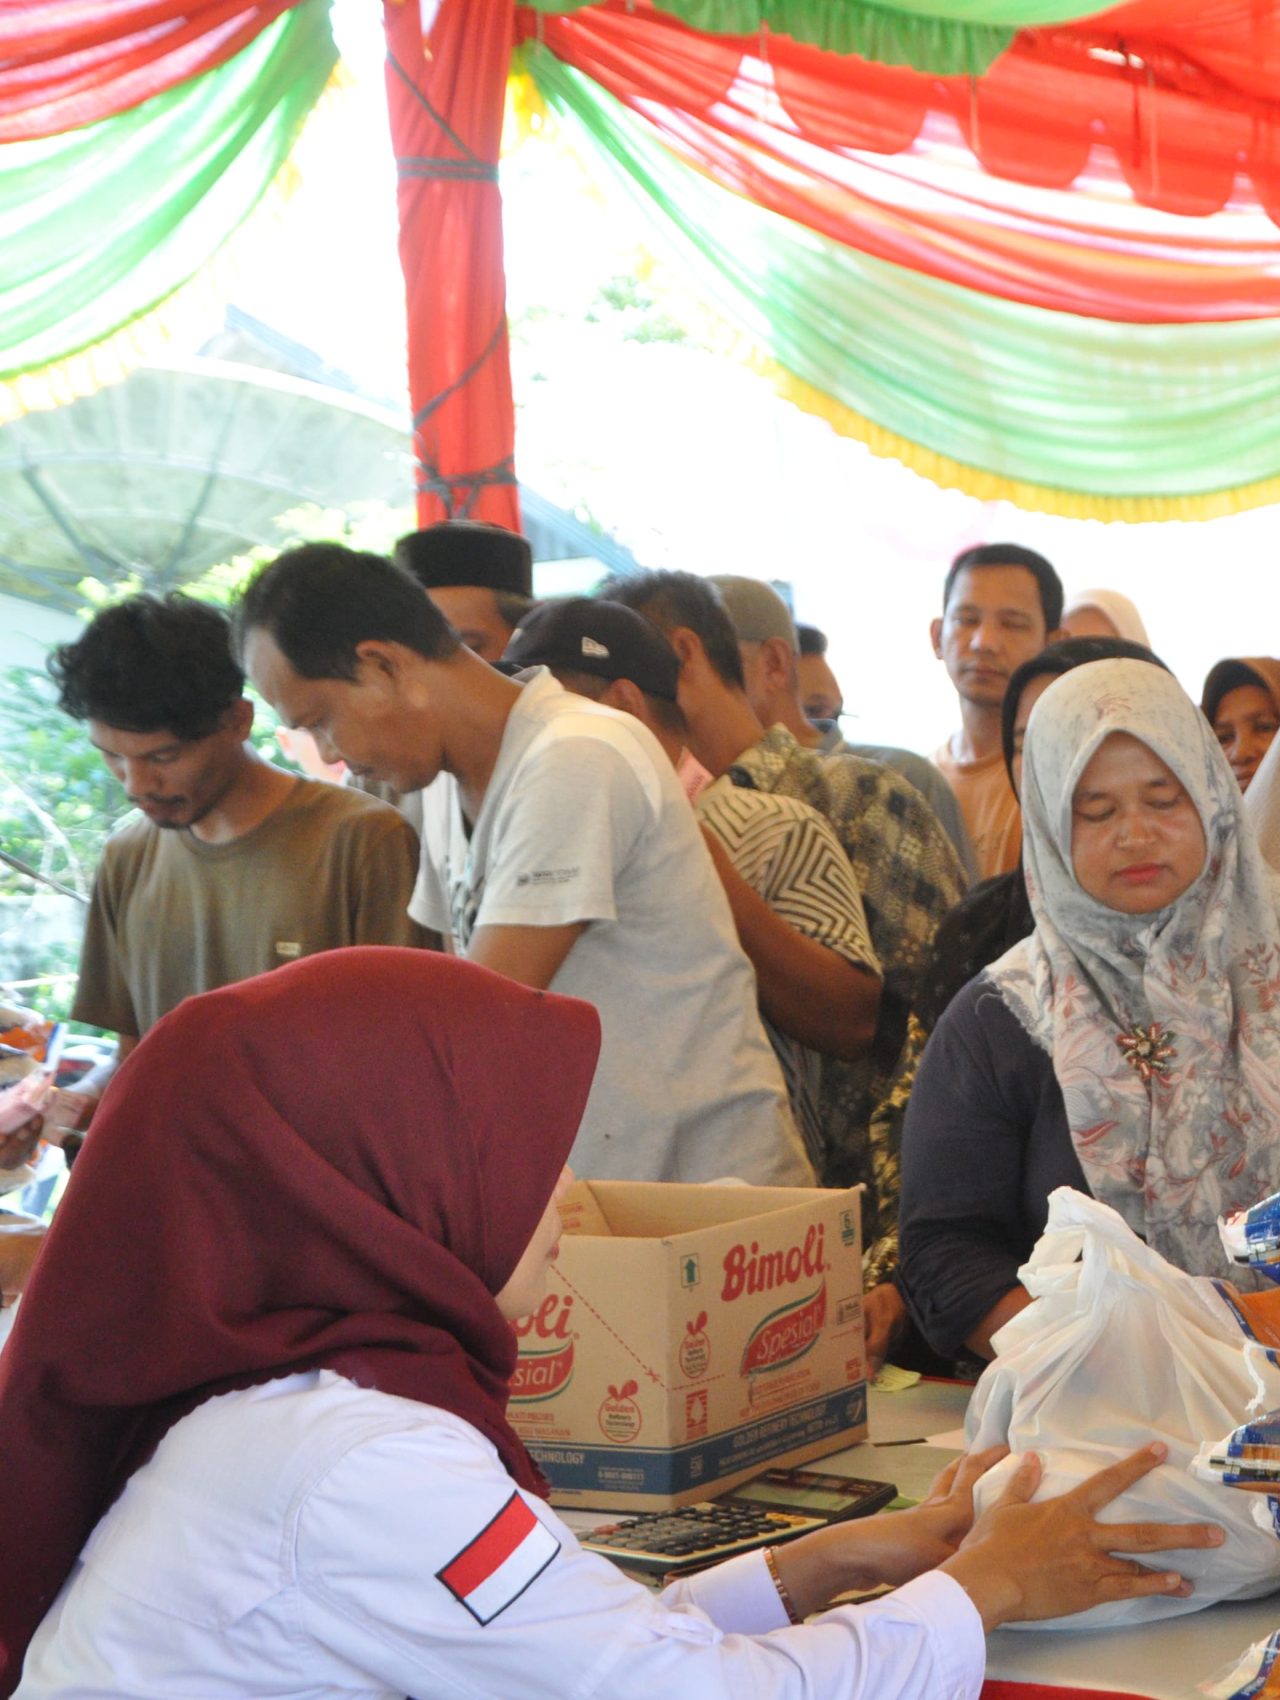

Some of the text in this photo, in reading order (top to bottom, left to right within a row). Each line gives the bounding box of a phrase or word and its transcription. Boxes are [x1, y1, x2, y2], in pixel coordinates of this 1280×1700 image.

[721, 1222, 825, 1303] Bimoli
[510, 1293, 575, 1340] oli
[756, 1304, 820, 1365] Spesial
[508, 1358, 557, 1388] sial
